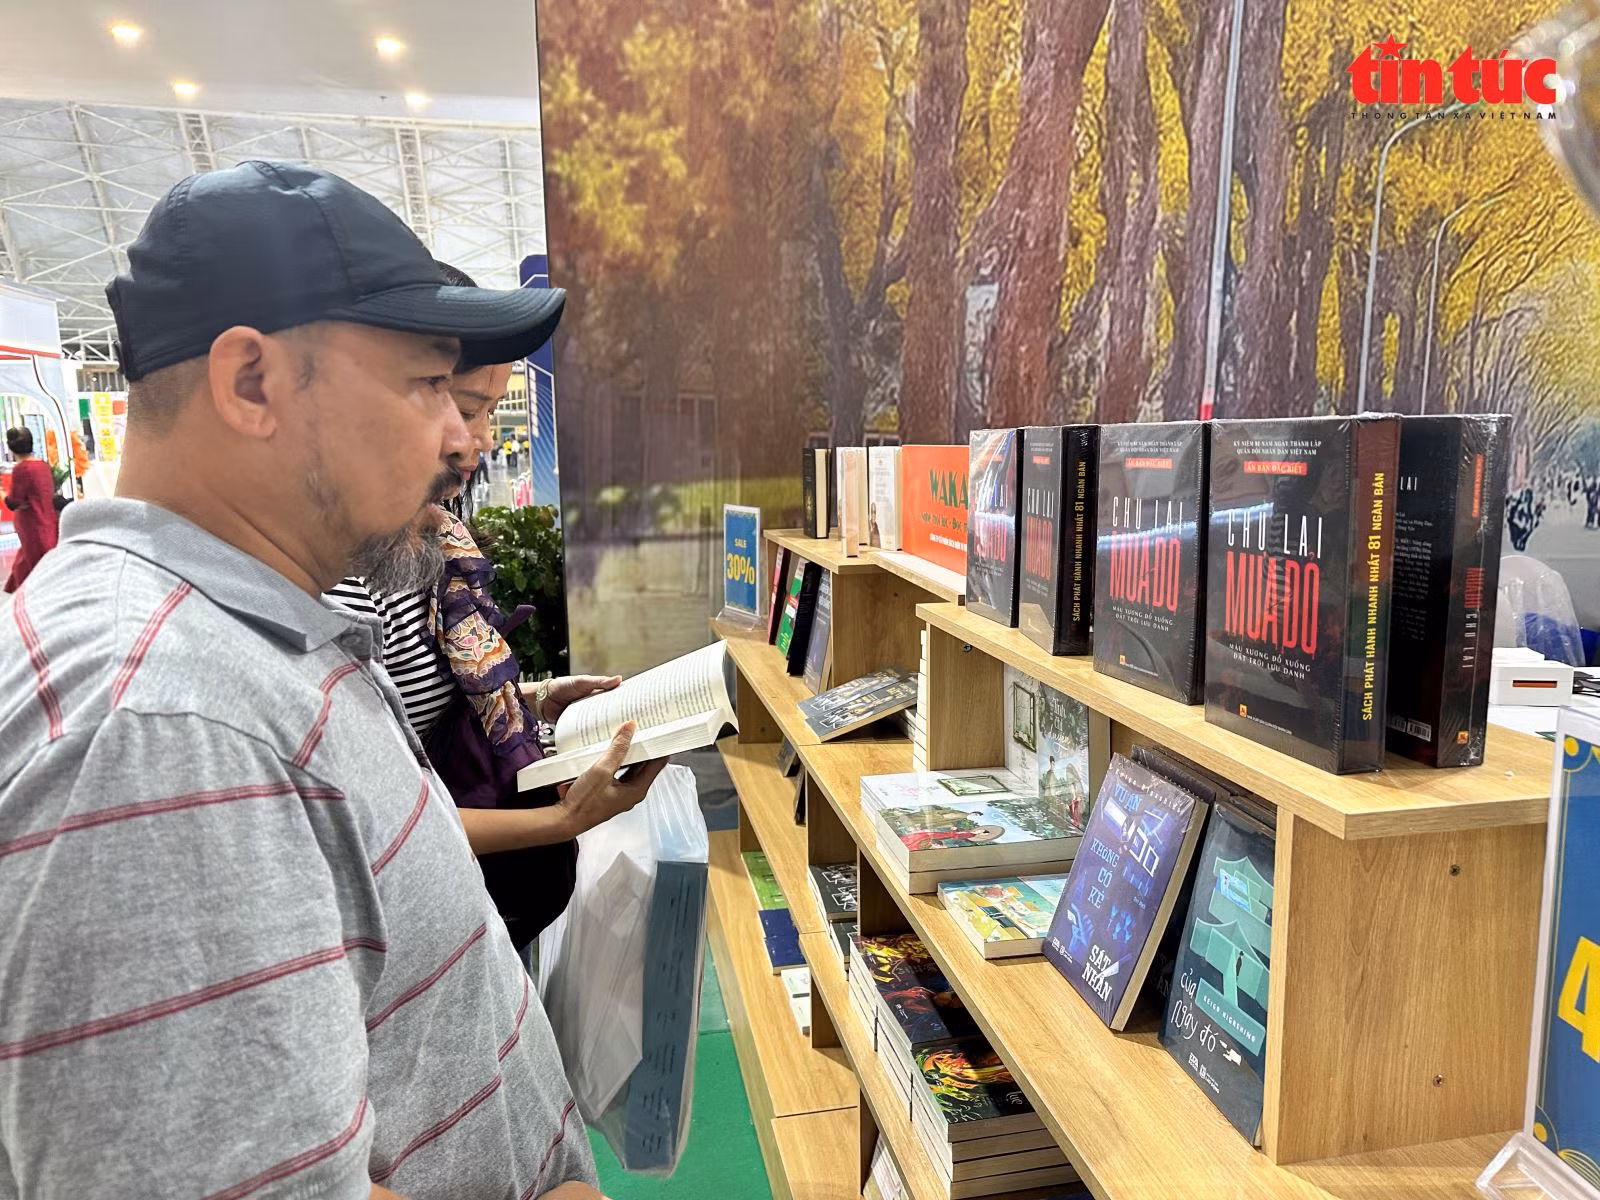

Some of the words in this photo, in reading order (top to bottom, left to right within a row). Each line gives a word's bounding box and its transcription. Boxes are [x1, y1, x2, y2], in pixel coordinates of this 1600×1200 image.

[1373, 472, 1385, 496] BẢN
[1074, 501, 1084, 511] 81
[1112, 495, 1142, 530] CHU
[1371, 502, 1383, 531] NGÀN
[1075, 533, 1083, 559] NHANH
[1227, 508, 1267, 551] CHU
[1283, 513, 1323, 559] LAI
[1368, 534, 1381, 550] 81
[727, 552, 755, 585] 30%
[1368, 552, 1380, 583] NHẤT
[1073, 583, 1081, 601] PHÁT
[1367, 586, 1379, 625] NHANH
[1072, 603, 1081, 622] SÁCH
[1464, 613, 1478, 638] CHU
[1365, 628, 1376, 658] HÀNH
[1462, 647, 1476, 668] LAI
[1284, 667, 1305, 680] DANH
[1364, 659, 1375, 691] PHÁT
[1362, 692, 1373, 720] SÁCH
[1097, 866, 1113, 889] CÓ
[1088, 944, 1112, 972] SÁT
